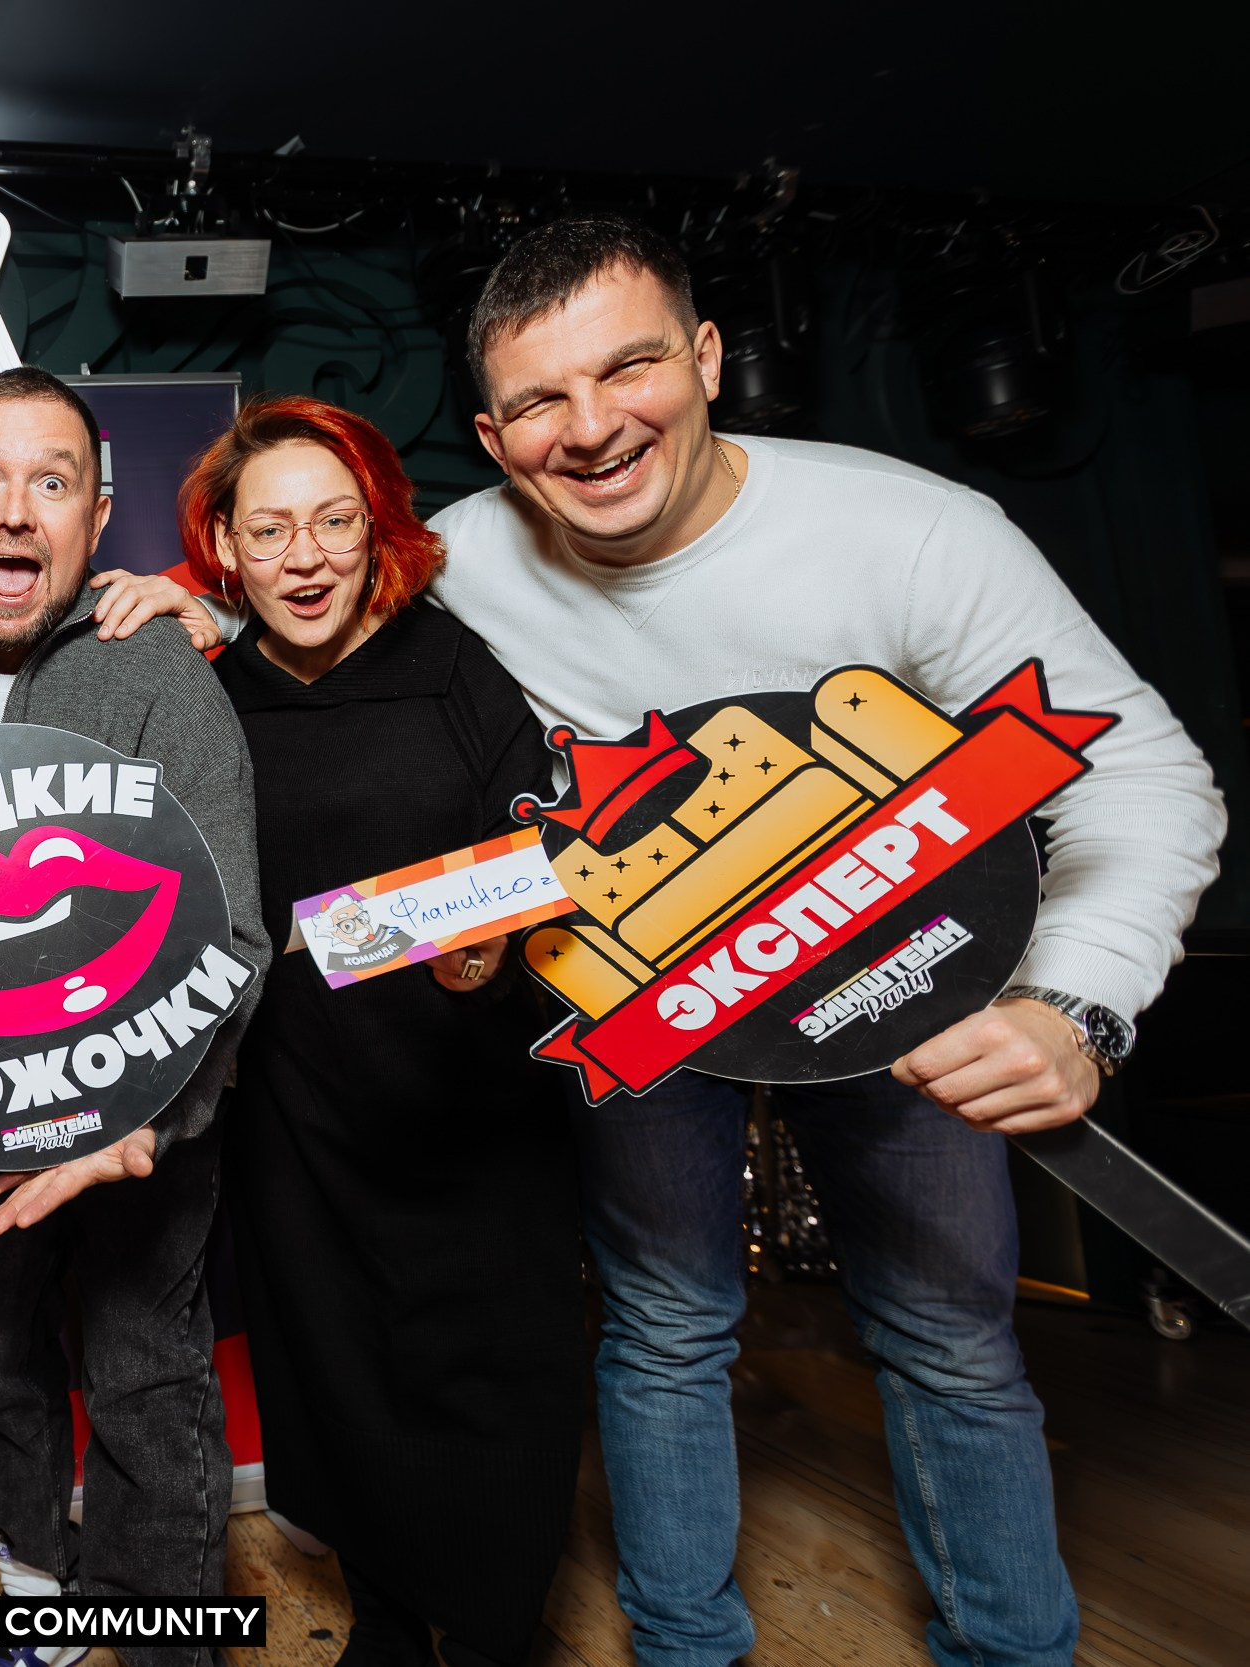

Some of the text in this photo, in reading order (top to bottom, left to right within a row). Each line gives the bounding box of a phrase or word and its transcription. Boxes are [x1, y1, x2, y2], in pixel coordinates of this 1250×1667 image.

[656, 787, 971, 1031] ЭКСПЕРТ
[797, 916, 969, 1038] ЭЙНШТЕЙН
[859, 967, 934, 1023] Party
[35, 1134, 75, 1153] Party
